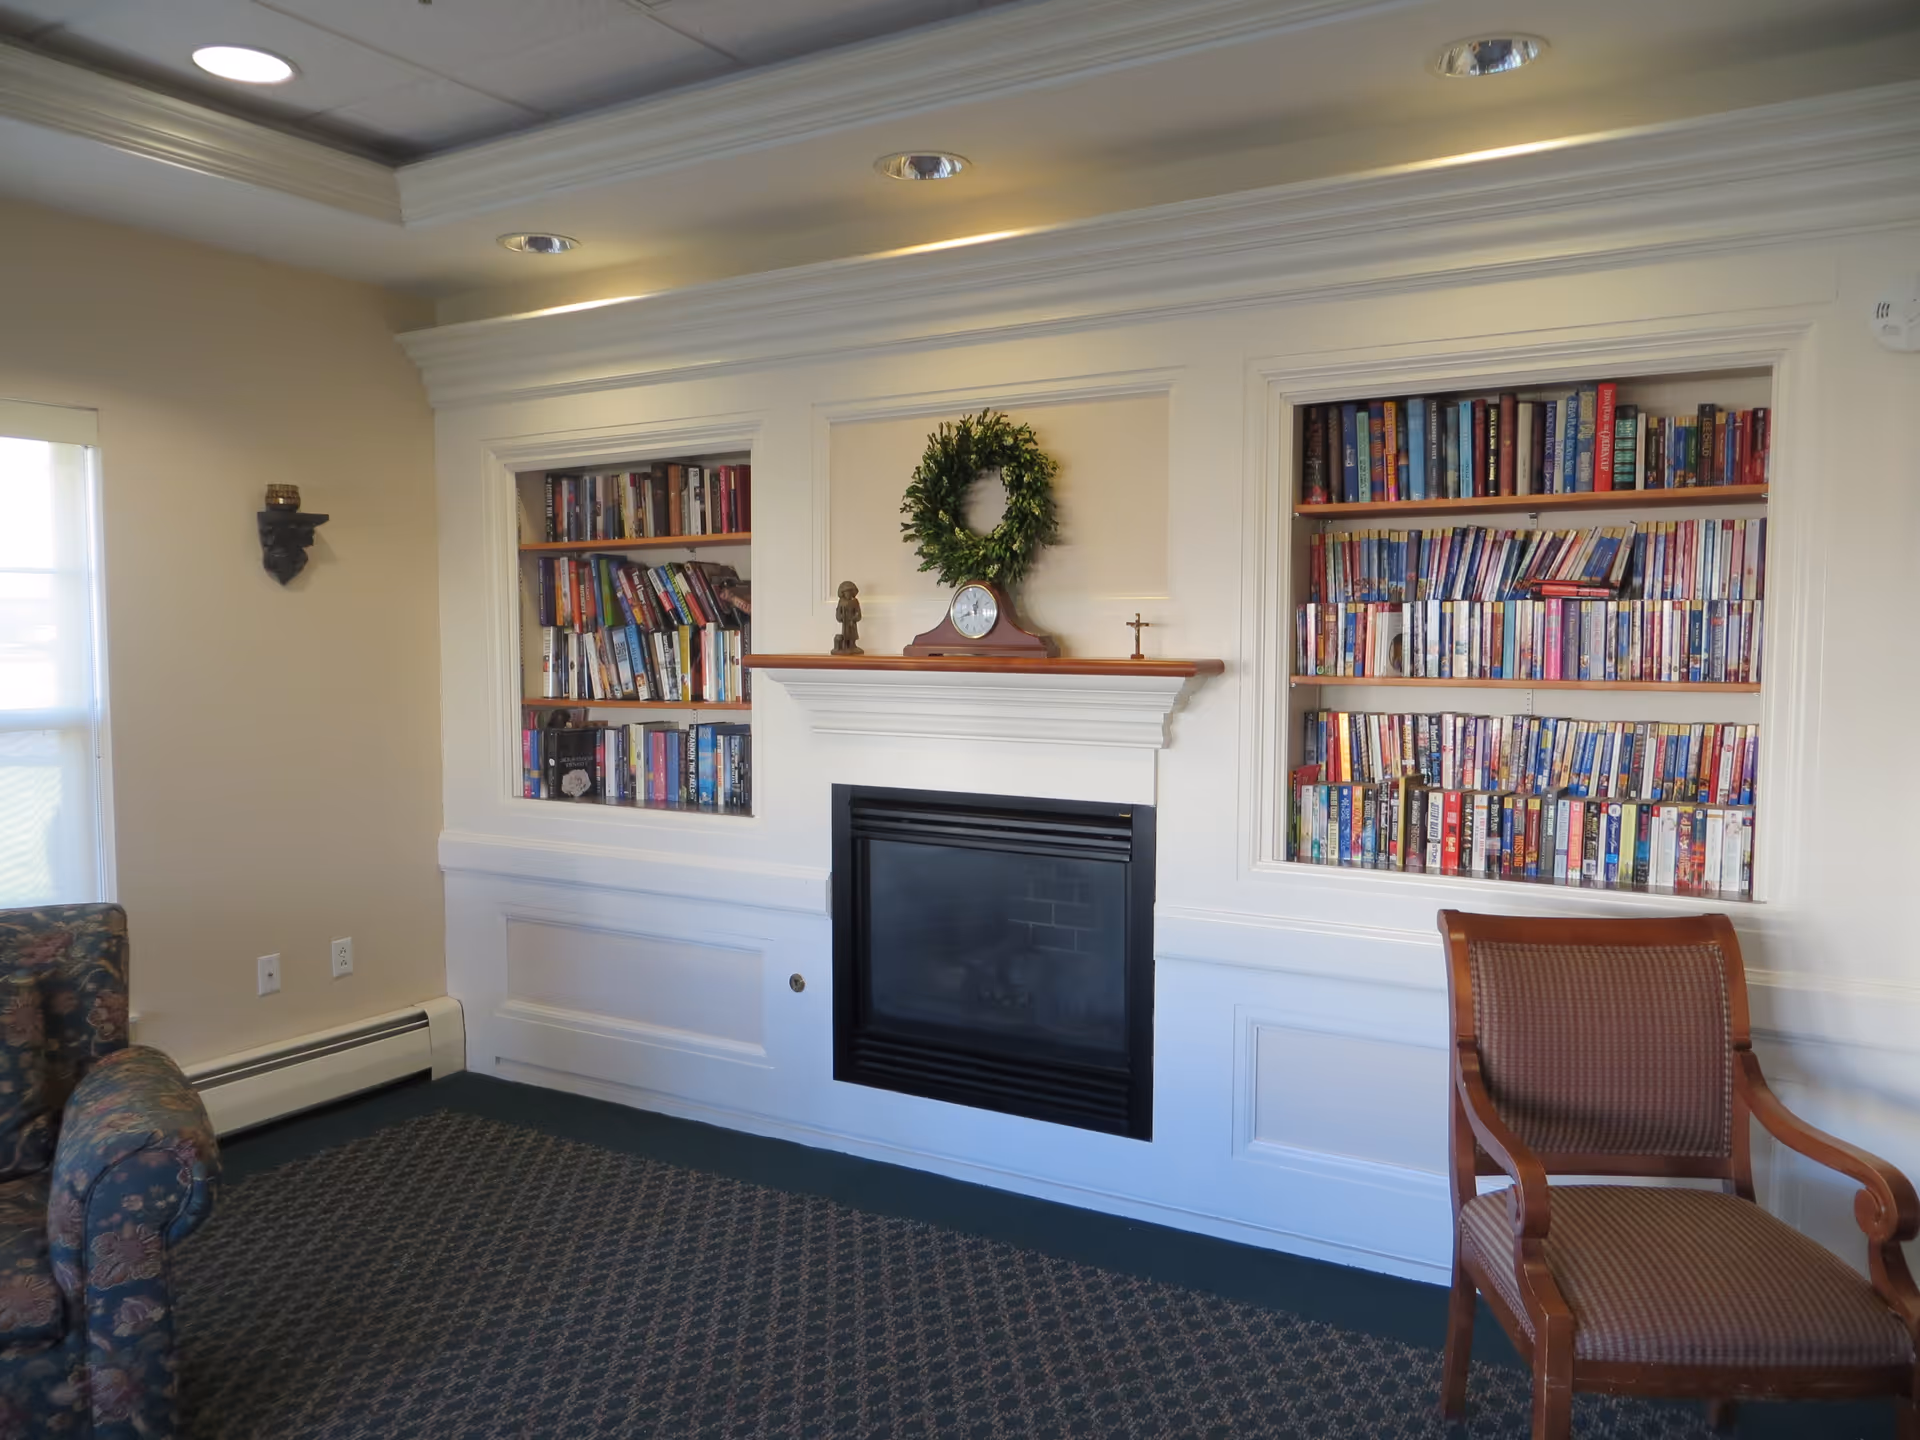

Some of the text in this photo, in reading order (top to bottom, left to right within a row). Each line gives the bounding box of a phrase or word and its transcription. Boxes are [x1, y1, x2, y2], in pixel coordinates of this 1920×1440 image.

[1597, 431, 1611, 458] GOLDEN
[1702, 417, 1712, 457] LEE CHILD
[1600, 458, 1609, 472] CUP
[689, 732, 697, 793] RANKIN THE FALLS
[1490, 818, 1499, 832] PLAIN
[1513, 835, 1524, 867] MISSING
